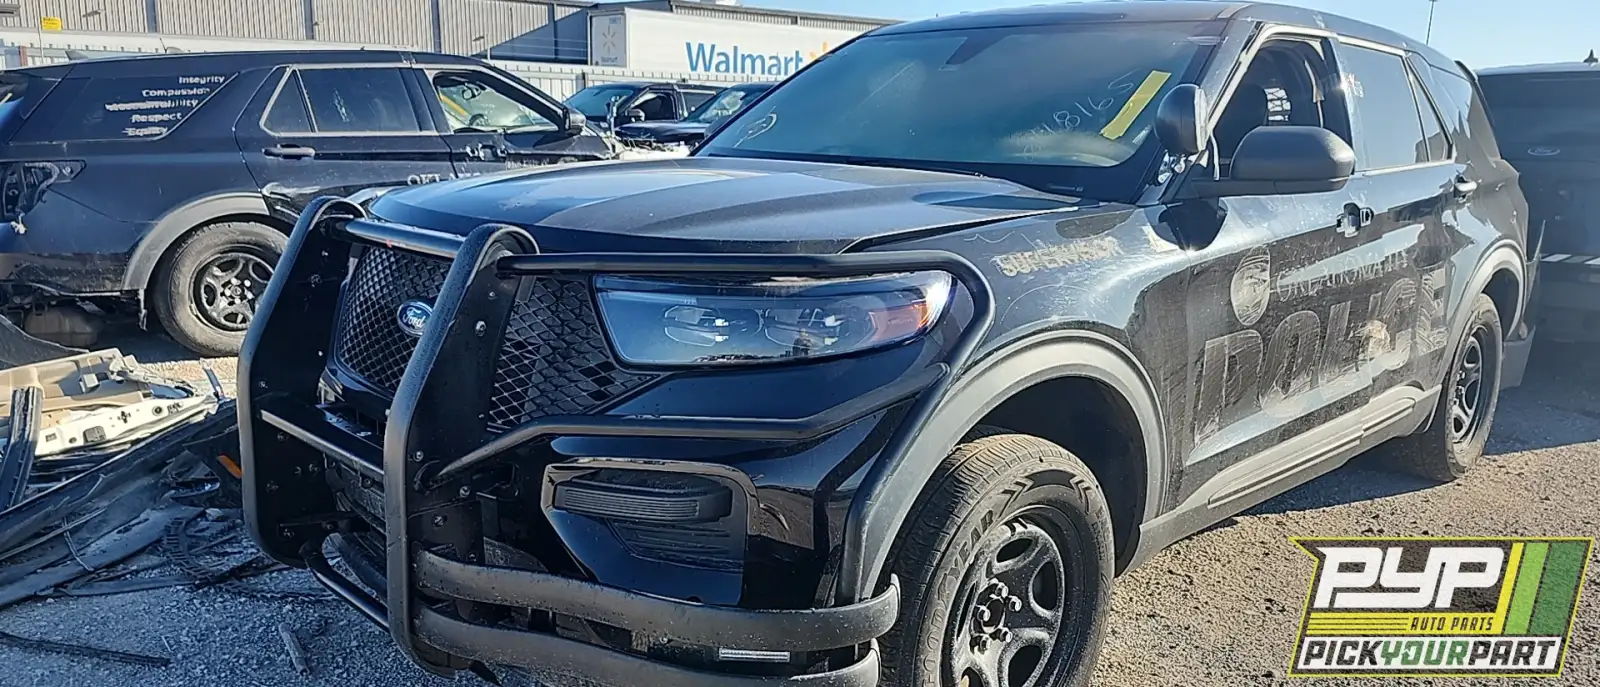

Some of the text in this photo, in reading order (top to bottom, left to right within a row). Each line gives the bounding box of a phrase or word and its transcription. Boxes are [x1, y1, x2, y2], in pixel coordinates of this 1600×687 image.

[685, 41, 803, 76] Walmart
[178, 75, 225, 85] Integrity
[131, 112, 182, 122] Respect
[401, 305, 429, 330] Ford
